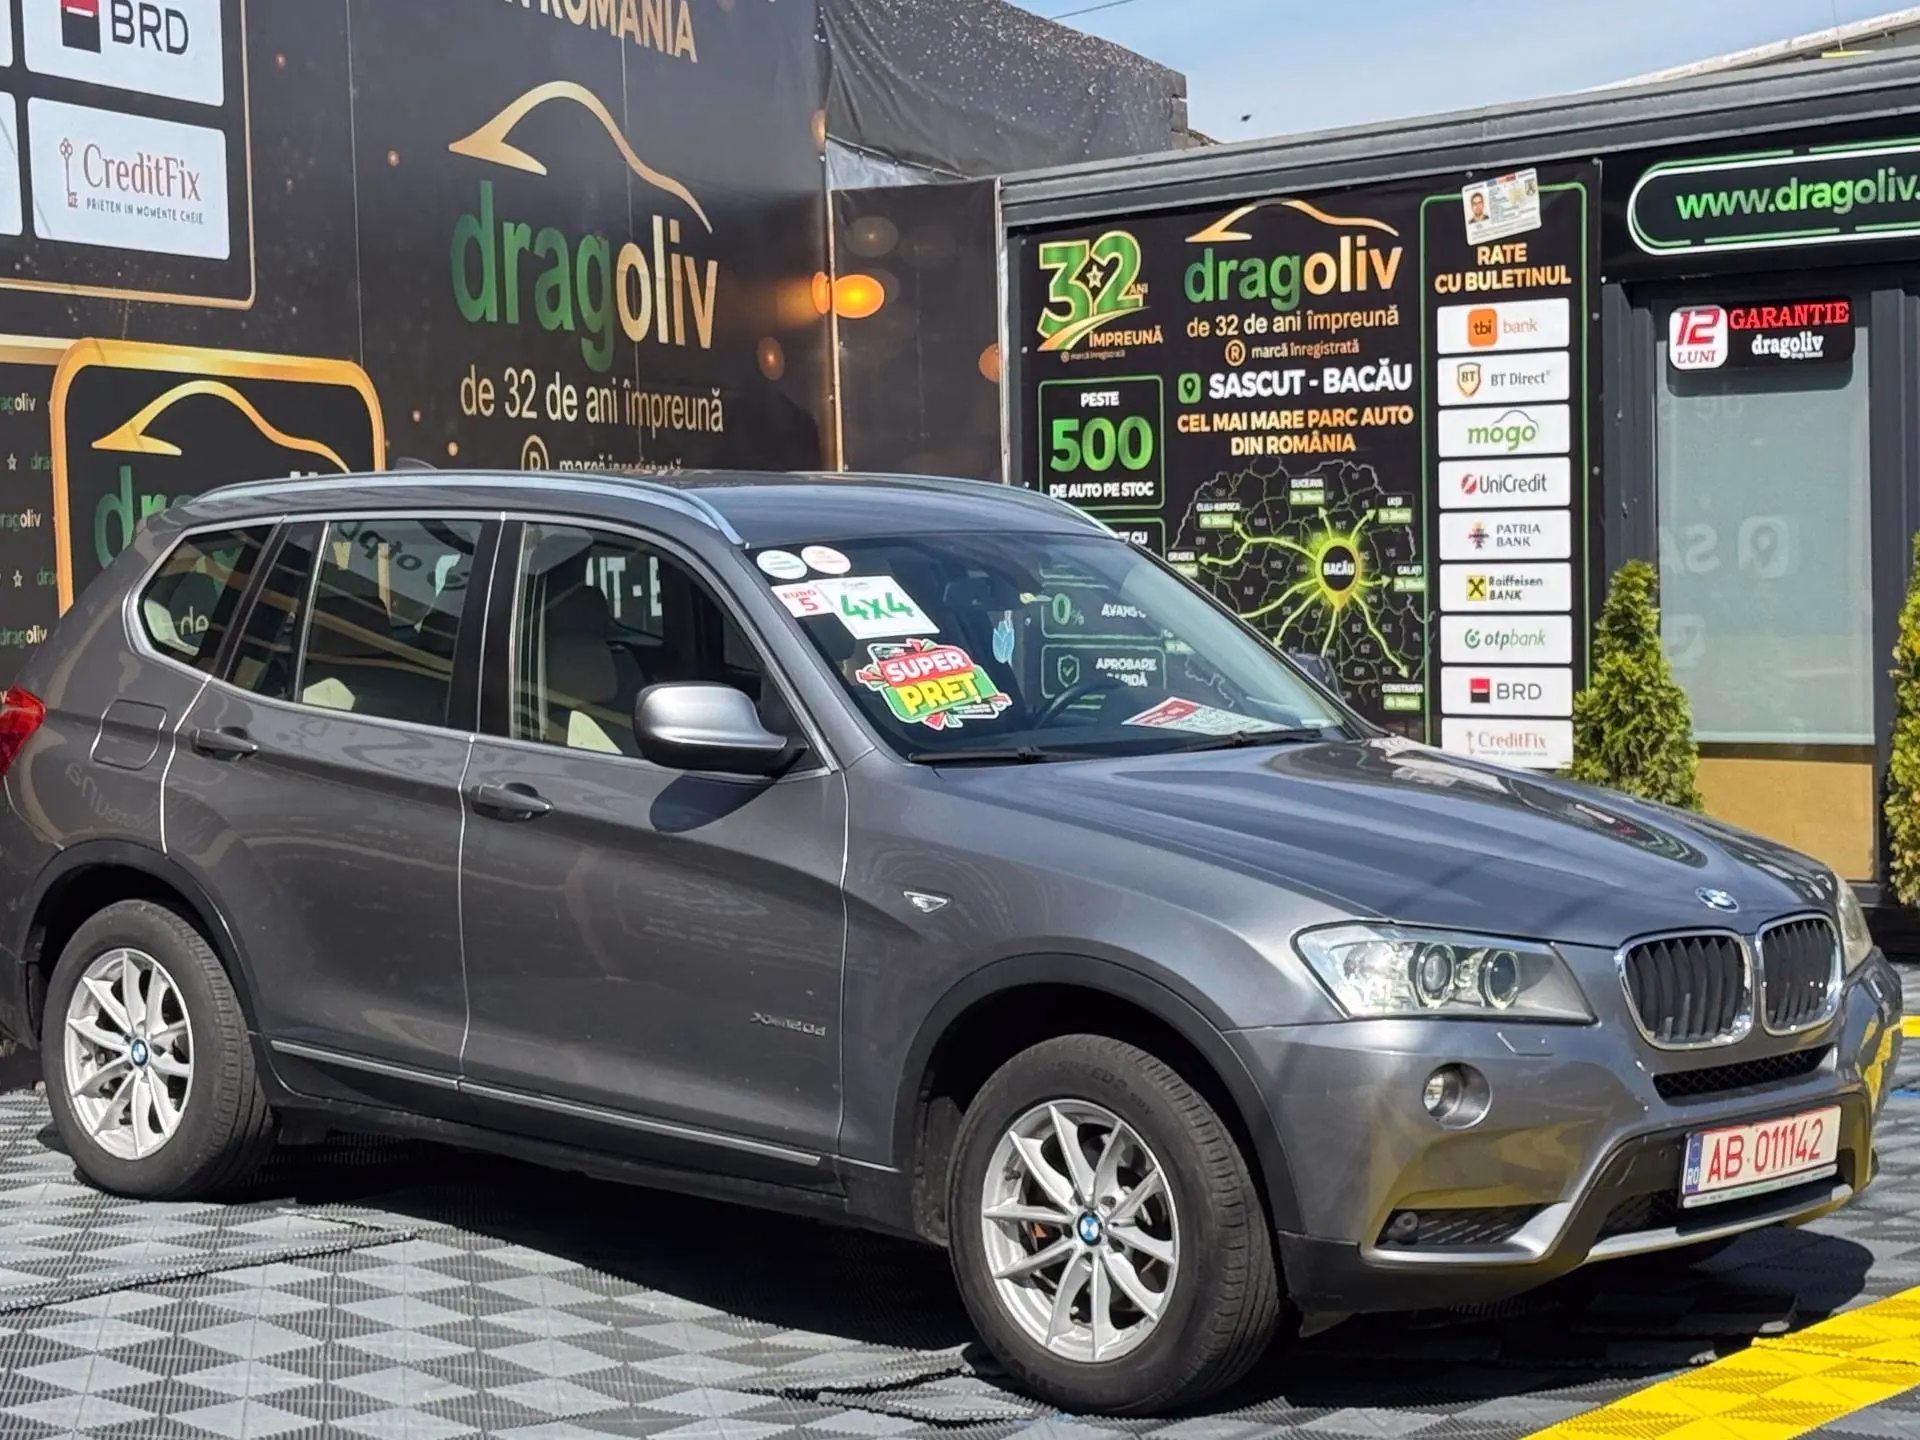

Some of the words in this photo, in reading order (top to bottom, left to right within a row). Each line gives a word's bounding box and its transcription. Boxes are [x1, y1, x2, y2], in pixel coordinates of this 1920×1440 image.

[111, 0, 189, 55] BRD
[84, 144, 201, 201] CreditFix
[87, 198, 121, 213] PRIETEN
[124, 204, 134, 215] IN
[137, 206, 177, 222] MOMENTE
[1477, 242, 1527, 266] RATE
[452, 180, 718, 373] dragoliv
[1184, 235, 1403, 311] dragoliv
[1434, 274, 1462, 294] CU
[1465, 265, 1572, 291] BULETINUL
[1037, 231, 1141, 339] 32
[1129, 282, 1148, 295] ANI
[1187, 318, 1209, 337] de
[1215, 316, 1238, 336] 32
[1243, 314, 1268, 334] de
[1273, 312, 1302, 332] ani
[1307, 306, 1399, 334] împreună
[1503, 318, 1538, 334] bank
[1676, 309, 1720, 346] 12
[1729, 302, 1849, 330] GARANTIE
[1089, 324, 1163, 347] ÎMPREUNĂ
[1473, 320, 1492, 336] tbi
[1252, 343, 1288, 360] marcă
[1290, 339, 1359, 360] înregistrată
[1751, 331, 1824, 359] dragoliv
[1677, 350, 1717, 364] LUNI
[1209, 370, 1305, 399] SASCUT
[1323, 359, 1413, 393] BACĂU
[1461, 371, 1476, 383] BT
[1491, 372, 1507, 386] BT
[460, 364, 494, 416] de
[504, 367, 537, 418] 32
[546, 371, 578, 422] de
[586, 377, 618, 425] ani
[625, 378, 723, 438] împreună
[1081, 391, 1119, 407] PESTE
[1177, 413, 1211, 433] CEL
[1213, 411, 1247, 431] MAI
[1251, 409, 1305, 430] MARE
[1307, 407, 1358, 427] PARC
[1361, 405, 1414, 426] AUTO
[1050, 415, 1154, 472] 500
[1231, 437, 1265, 456] DIN
[1266, 430, 1356, 454] ROMÂNIA
[1468, 423, 1536, 451] mogo
[1049, 484, 1067, 498] DE
[1068, 483, 1102, 498] AUTO
[1104, 483, 1119, 497] PE
[1121, 481, 1154, 496] STOC
[1479, 473, 1547, 495] UniCredit
[1496, 523, 1541, 535] PATRIA
[1496, 536, 1531, 547] BANK
[1489, 575, 1543, 587] Raiffeisen
[798, 597, 818, 611] 5
[1489, 589, 1522, 601] BANK
[1484, 629, 1546, 650] otpbank
[886, 651, 967, 682] SUPER
[1096, 657, 1157, 671] APROBARE
[1496, 683, 1542, 700] BRD
[1478, 731, 1546, 749] CreditFix
[1707, 1135, 1744, 1184] AB
[1754, 1118, 1823, 1175] 011142
[1687, 1168, 1699, 1185] RO
